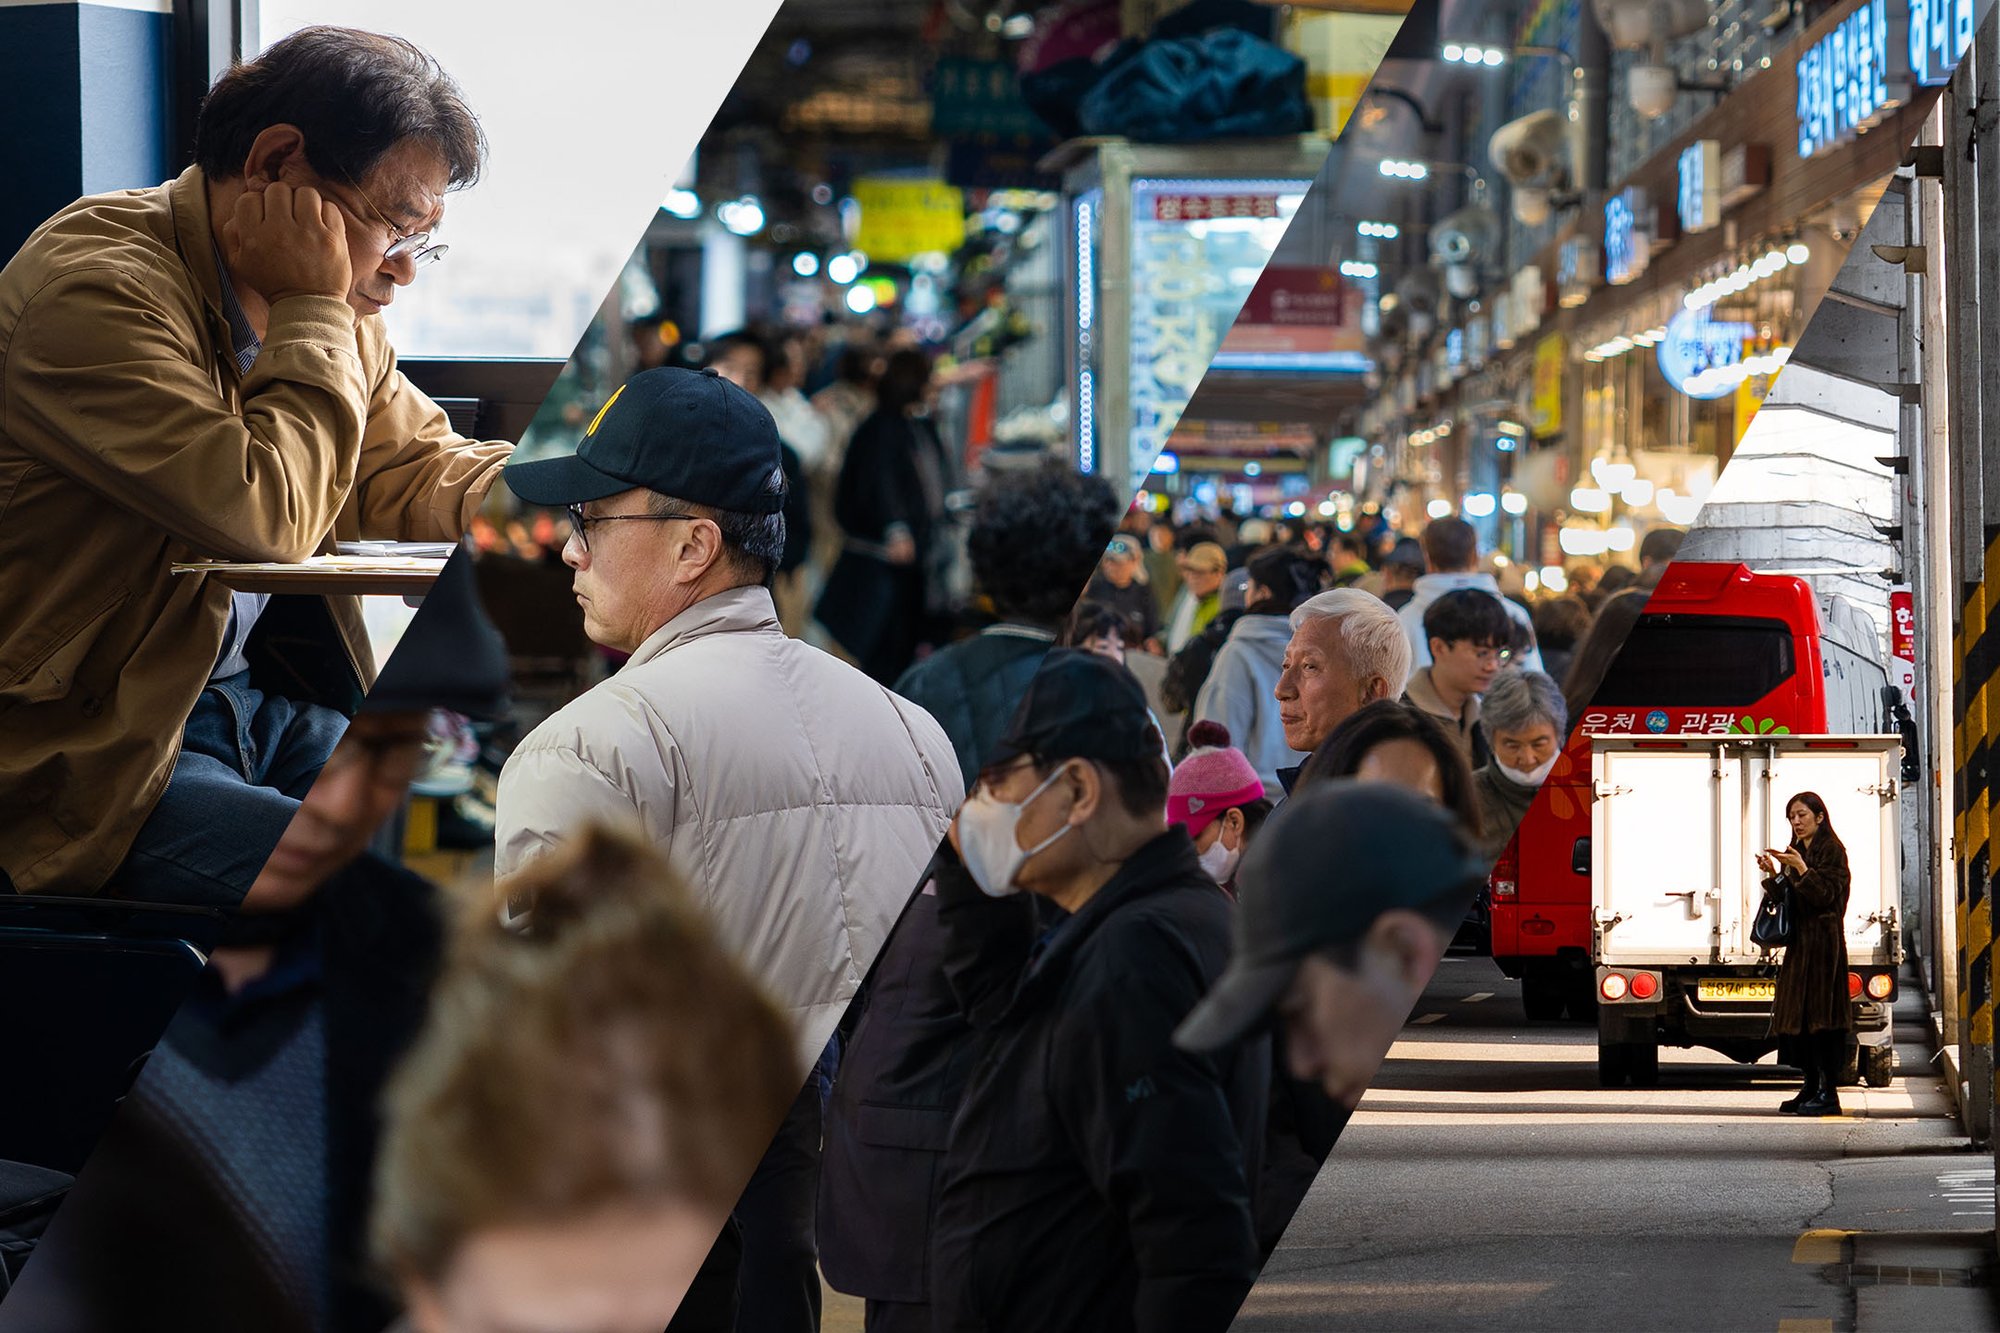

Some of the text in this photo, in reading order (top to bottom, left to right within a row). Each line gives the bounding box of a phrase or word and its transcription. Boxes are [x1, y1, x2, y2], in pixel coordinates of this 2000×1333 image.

[1581, 713, 1735, 736] 운천 관광
[1749, 982, 1776, 997] 530
